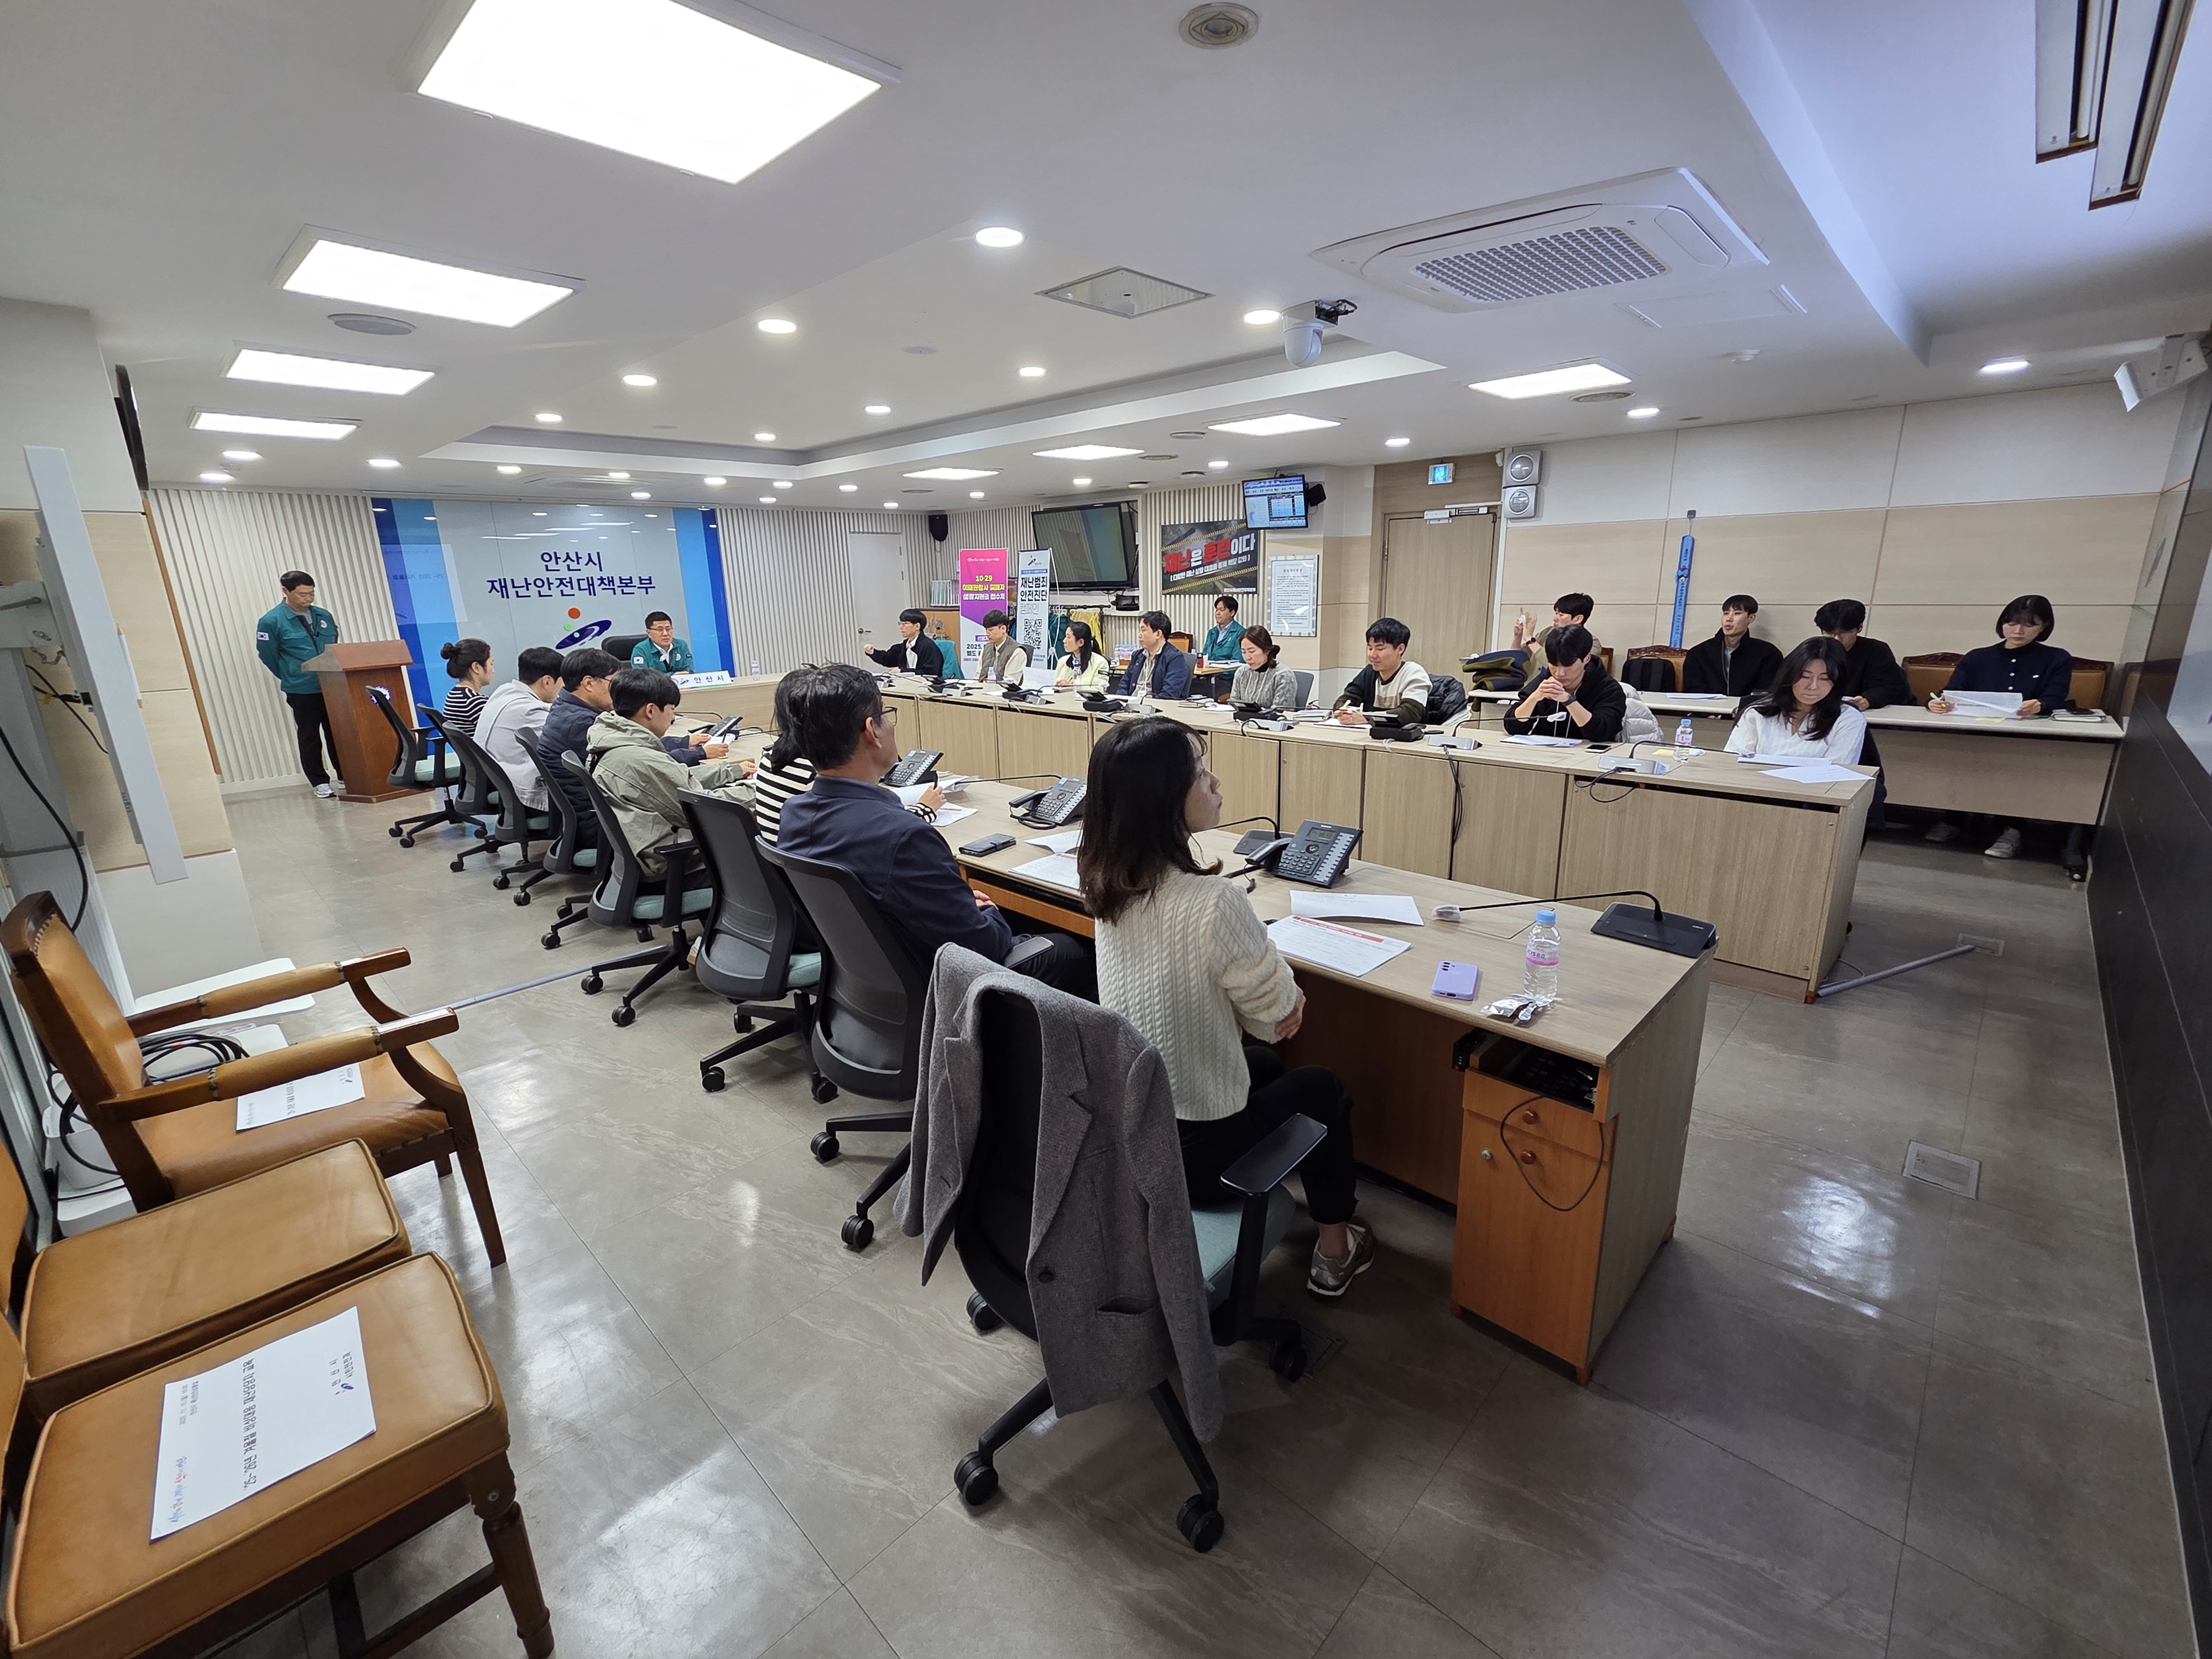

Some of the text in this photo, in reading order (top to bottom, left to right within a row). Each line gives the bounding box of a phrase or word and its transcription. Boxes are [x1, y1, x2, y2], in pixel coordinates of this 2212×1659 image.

[540, 551, 604, 573] 안산시
[1164, 533, 1255, 573] 재난은 훈련이다
[487, 575, 656, 599] 재난안전대책본부
[1020, 576, 1047, 588] 재난범죄
[1020, 589, 1047, 601] 안전진단
[694, 675, 724, 684] 안산시
[243, 1358, 255, 1373] 교육
[328, 1358, 341, 1386] 안산시
[342, 1352, 354, 1379] 시민안전과
[243, 1372, 256, 1405] 재난담당자
[243, 1404, 257, 1433] 비상대응
[243, 1431, 257, 1455] 겨울철
